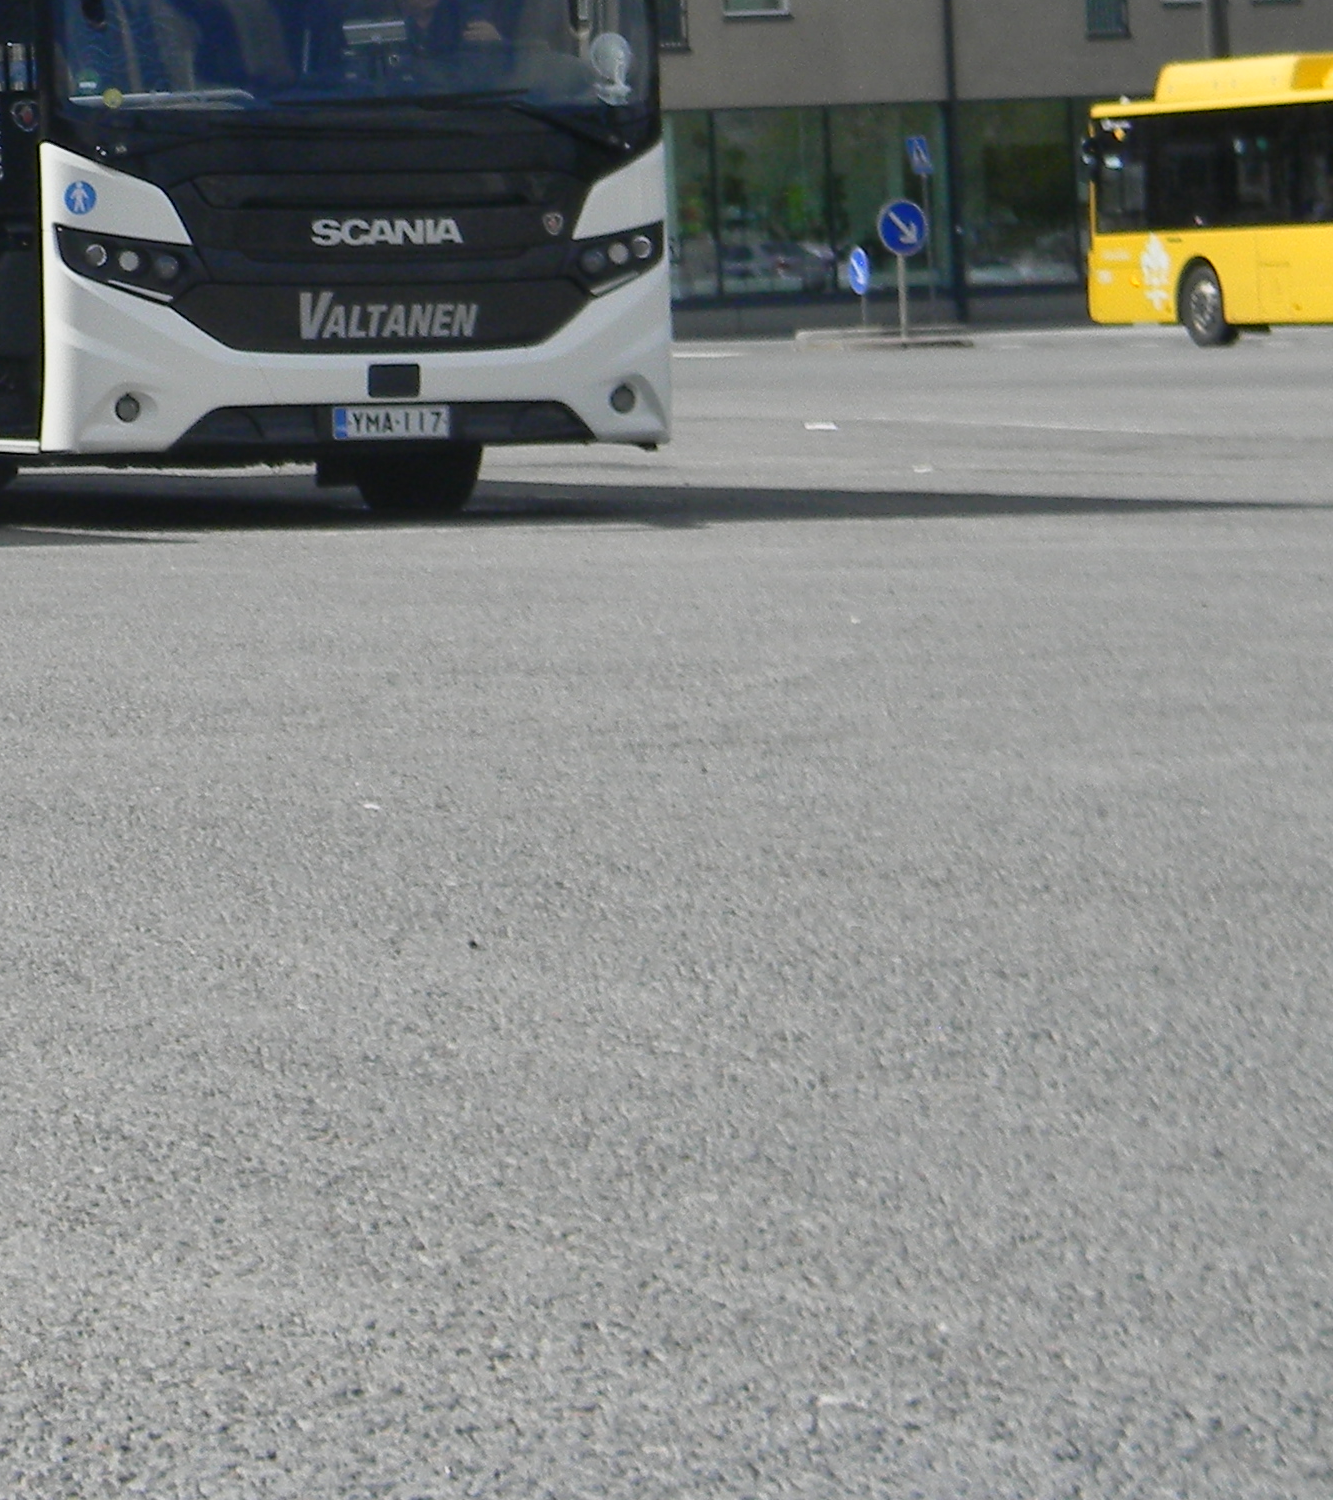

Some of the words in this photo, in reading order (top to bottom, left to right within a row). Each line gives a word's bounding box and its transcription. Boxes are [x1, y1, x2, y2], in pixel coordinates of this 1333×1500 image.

[310, 218, 464, 247] SCANIA
[299, 291, 479, 341] VALTANEN
[352, 411, 442, 433] YMA-117
